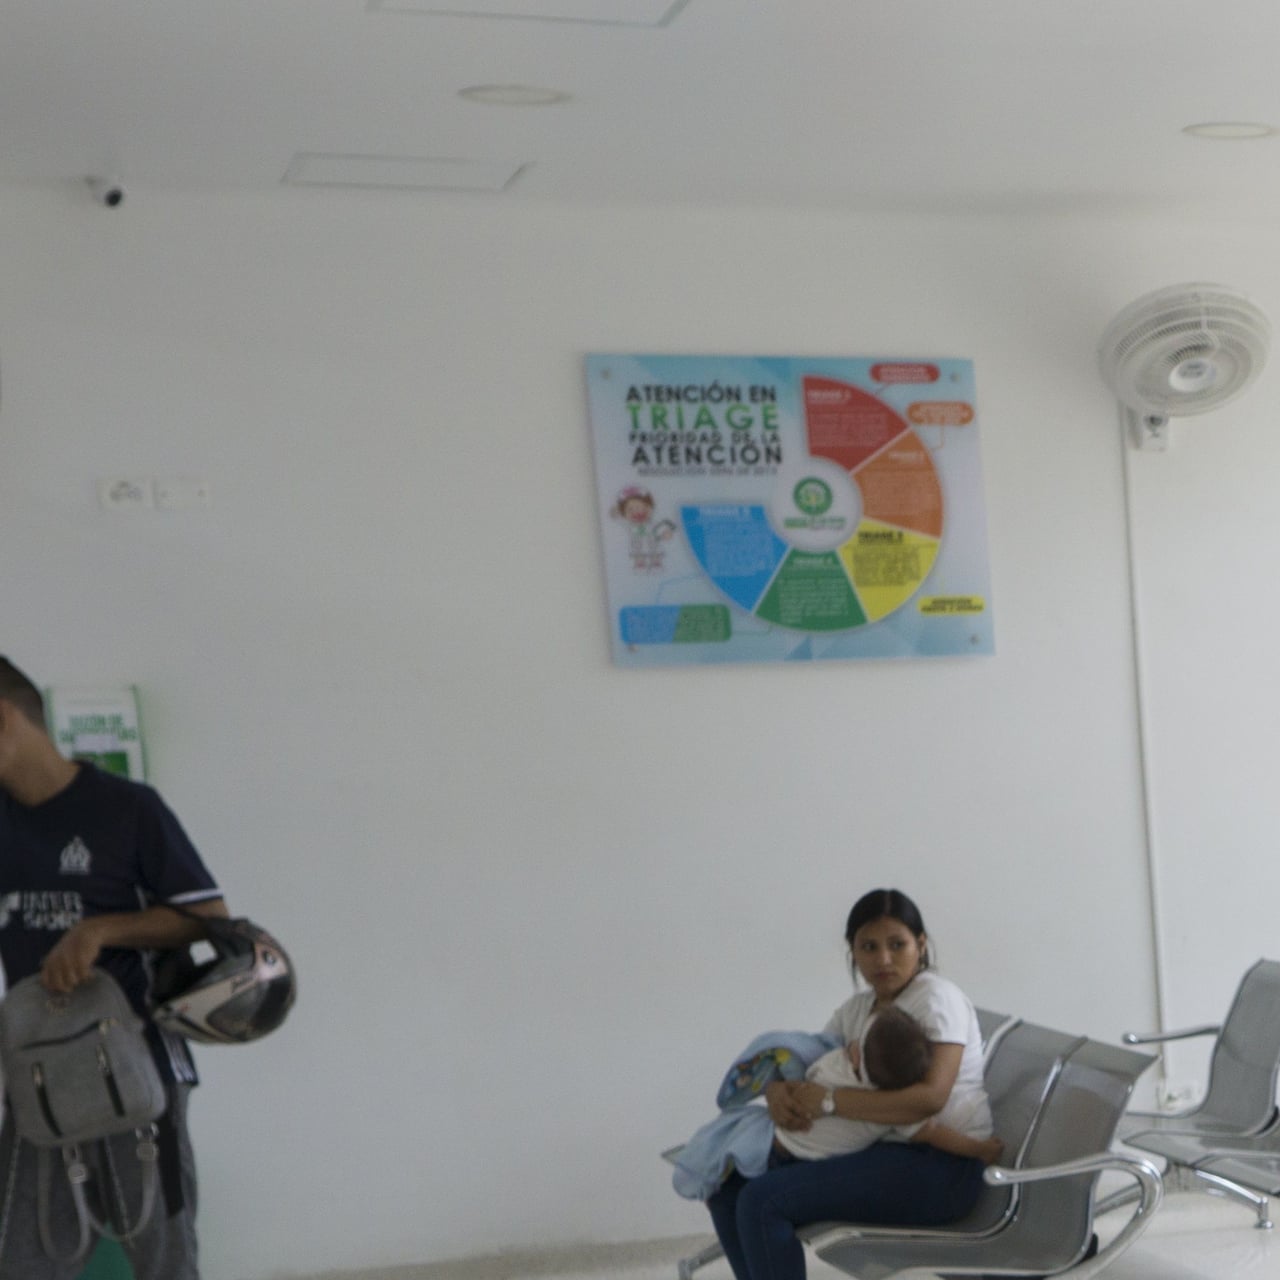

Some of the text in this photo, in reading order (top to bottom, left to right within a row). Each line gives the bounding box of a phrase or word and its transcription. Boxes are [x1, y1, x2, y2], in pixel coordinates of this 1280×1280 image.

[627, 380, 776, 403] ATENCIÓN EN
[626, 403, 779, 430] TRIAGE
[629, 431, 780, 444] PRIORIDAD DE LA
[632, 443, 782, 465] ATENCIÓN
